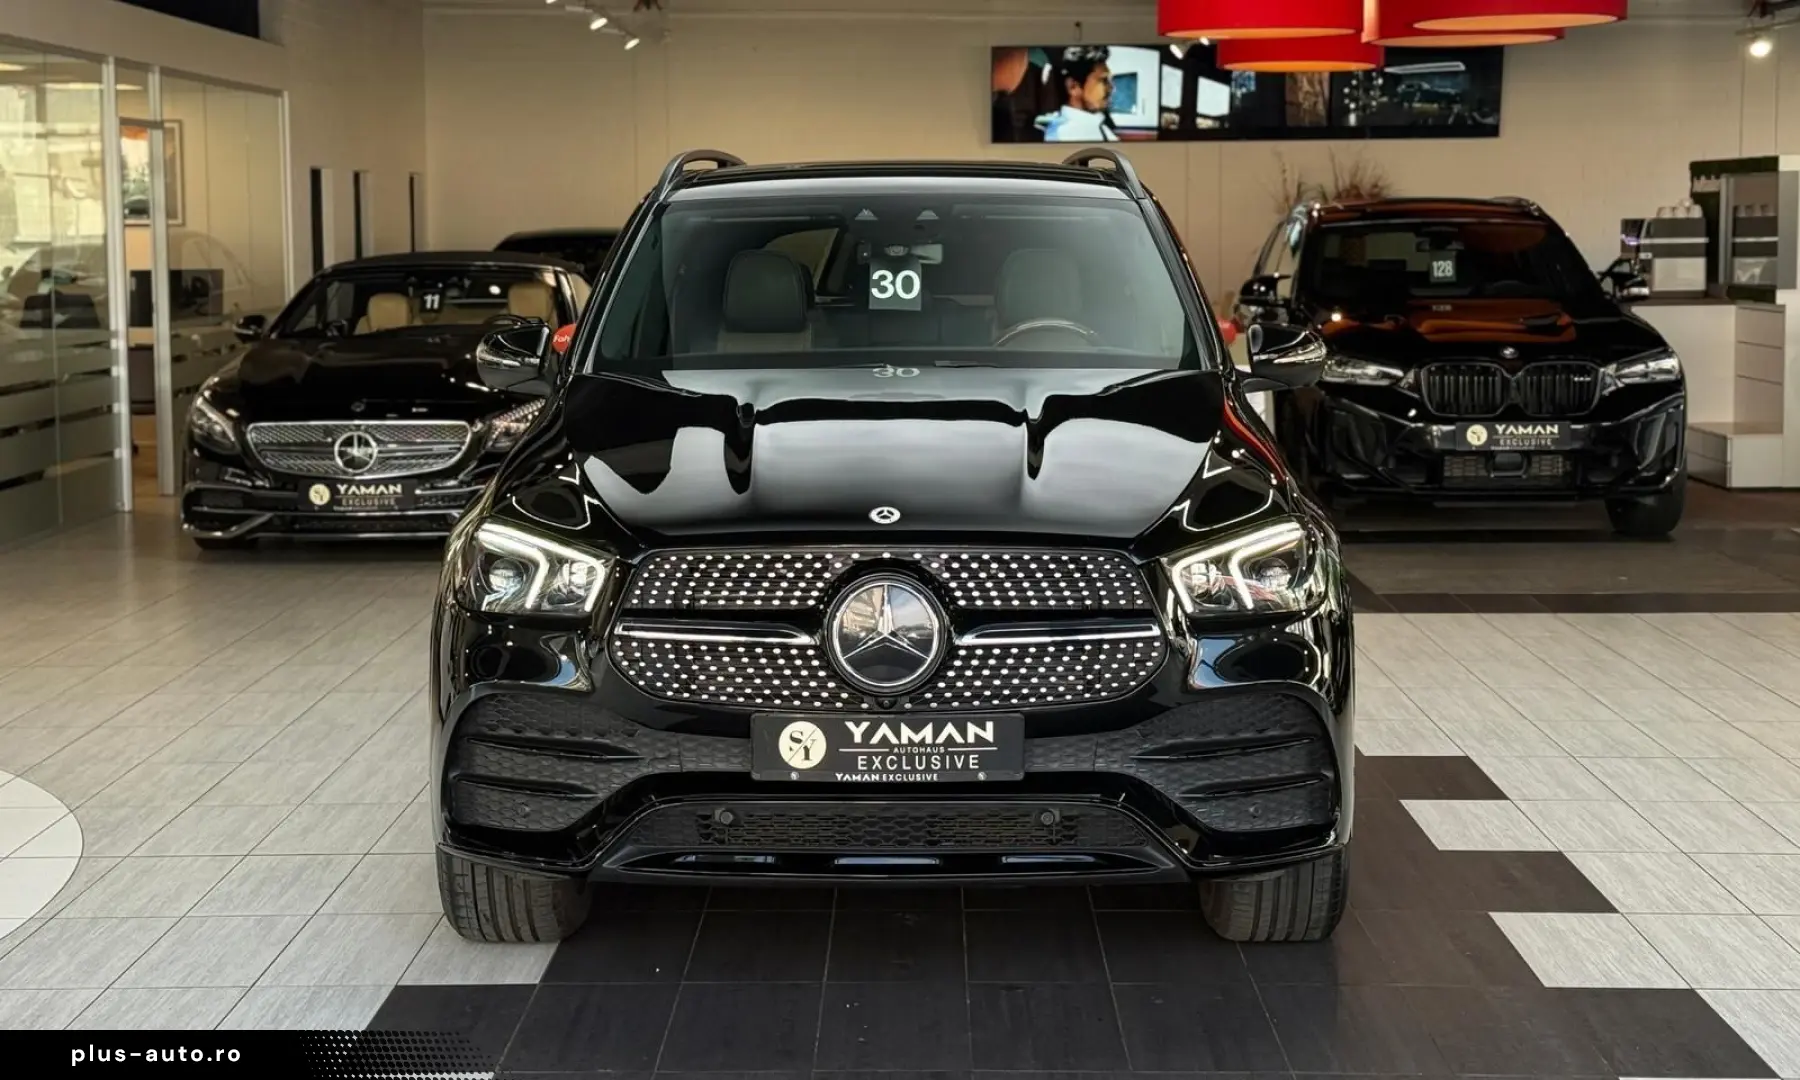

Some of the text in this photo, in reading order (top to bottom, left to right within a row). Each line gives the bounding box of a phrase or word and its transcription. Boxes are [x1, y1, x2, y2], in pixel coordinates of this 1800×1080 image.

[1432, 260, 1453, 277] 128
[871, 269, 920, 299] 30
[424, 294, 440, 309] 11
[1495, 423, 1559, 434] YAMAN
[1500, 438, 1552, 446] EXCLUSIVE
[336, 483, 402, 495] YAMAN
[341, 497, 396, 506] EXCLUSIVE
[844, 720, 995, 745] YAMAN
[892, 746, 945, 754] AUTOHAUS
[857, 754, 980, 771] EXCLUSIVE
[835, 772, 939, 782] YAMAN EXCLUSIVE
